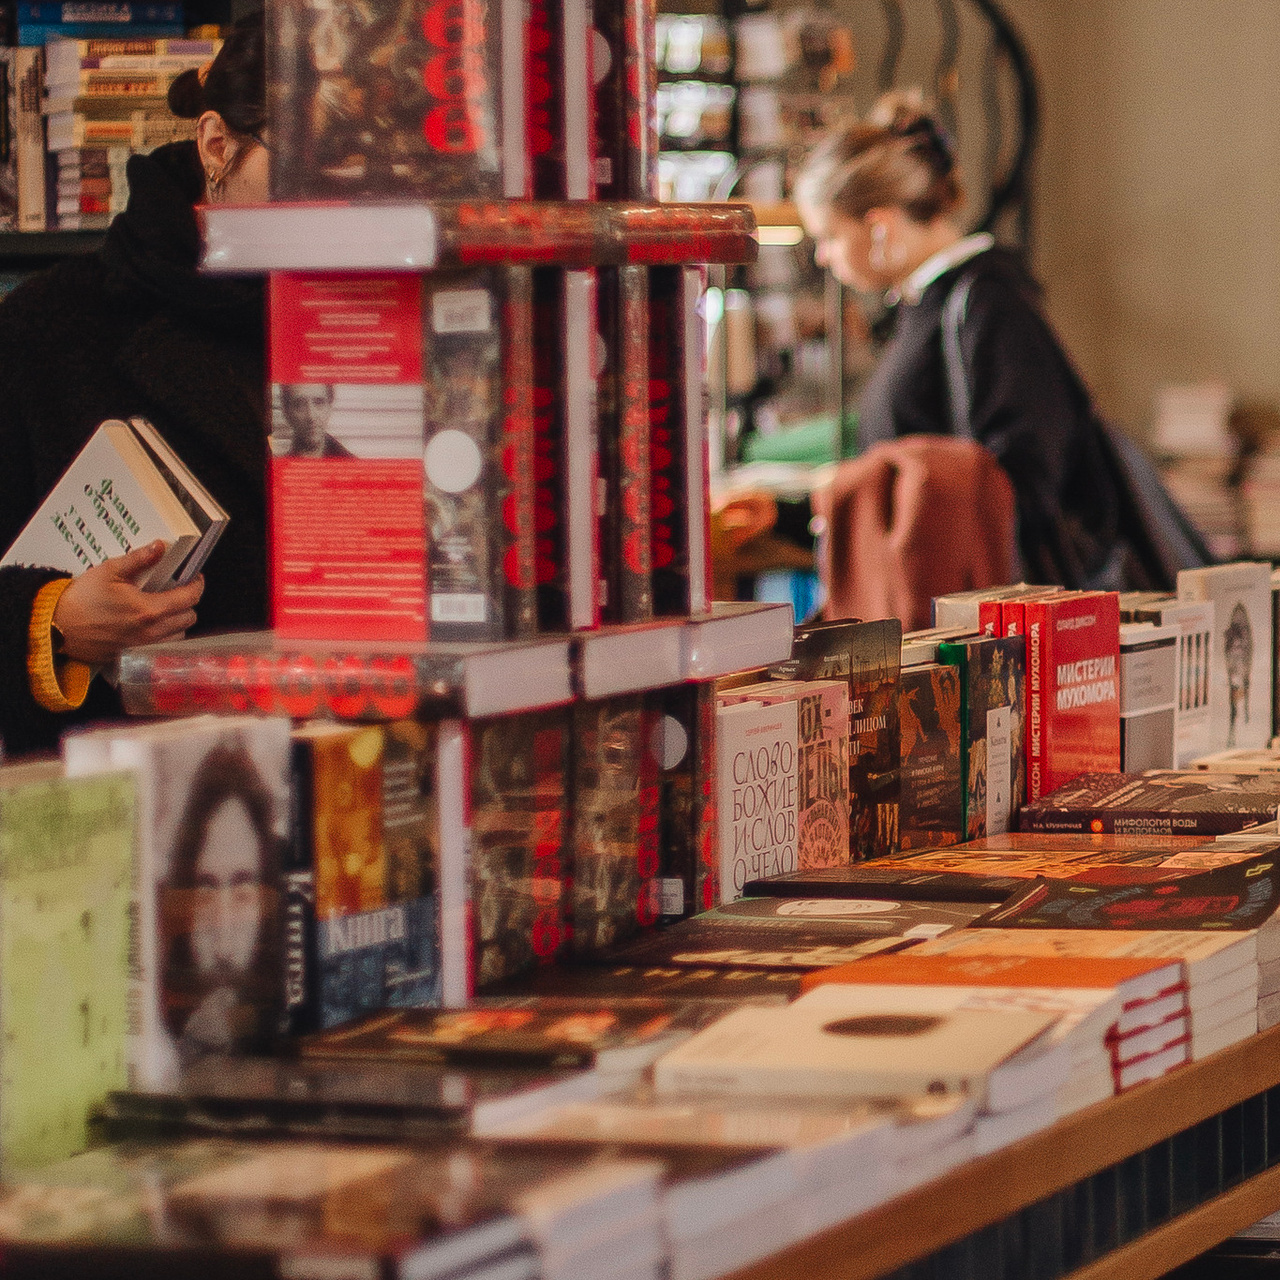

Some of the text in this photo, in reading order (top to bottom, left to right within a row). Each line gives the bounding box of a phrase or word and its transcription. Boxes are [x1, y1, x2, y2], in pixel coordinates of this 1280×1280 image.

[1030, 622, 1041, 690] МУХОМОРА
[1056, 656, 1116, 687] МИСТЕРИИ
[1056, 681, 1117, 711] МУХОМОРА
[853, 715, 887, 736] ЛИЦОМ
[1030, 694, 1041, 757] МИСТЕРИИ
[1113, 817, 1198, 829] МИФОЛОГИЯ ВОДЫ
